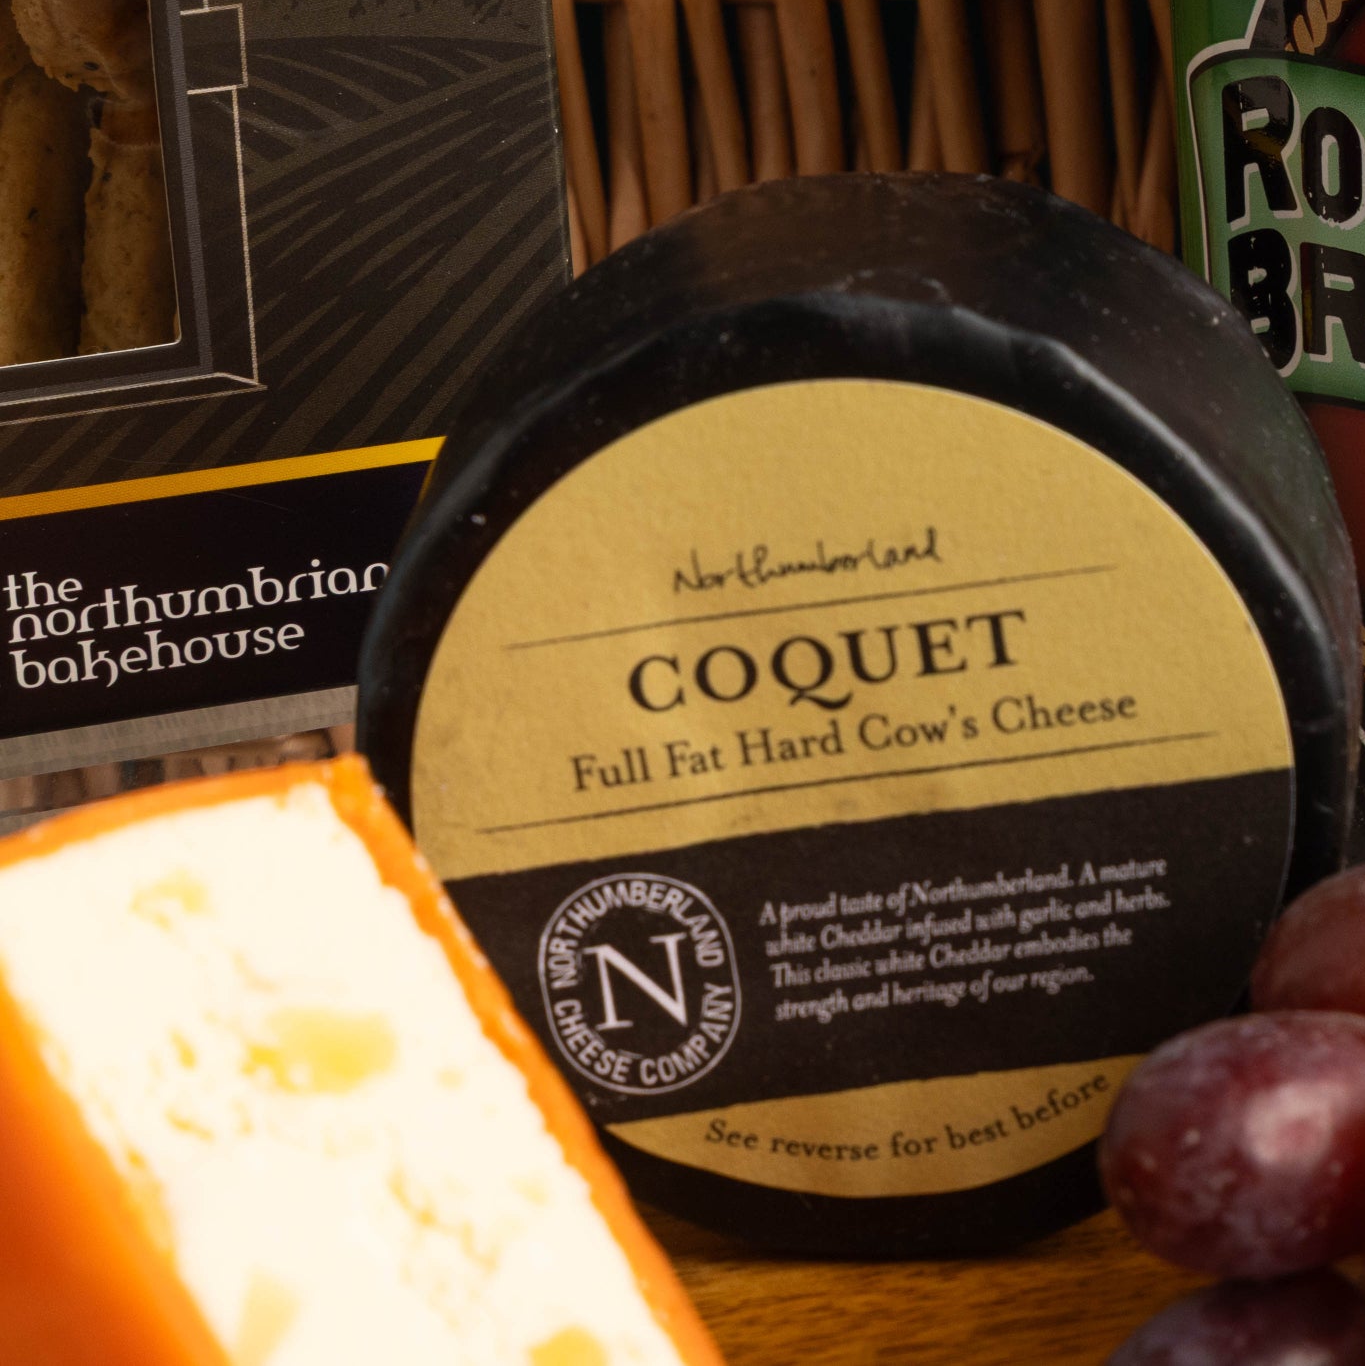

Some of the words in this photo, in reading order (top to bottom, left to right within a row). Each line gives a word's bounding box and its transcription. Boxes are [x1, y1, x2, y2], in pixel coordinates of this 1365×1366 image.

[3, 571, 83, 612] the
[8, 559, 390, 644] northumbrian
[9, 622, 305, 689] bakehouse
[627, 609, 1027, 713] COQUET
[569, 746, 653, 793] Full
[664, 739, 727, 779] Fat
[735, 718, 846, 768] Hard
[857, 703, 979, 751] Cow's
[991, 693, 1138, 735] Cheese
[548, 880, 725, 990] NORTHUMBERLAND
[758, 901, 777, 926] A
[779, 891, 837, 931] proud
[840, 892, 884, 916] taste
[886, 882, 909, 917] of
[909, 863, 1074, 907] Northumberland.
[1078, 861, 1097, 885] A
[1099, 859, 1167, 882] mature
[765, 930, 816, 957] white
[820, 918, 903, 951] Cheddar
[905, 908, 972, 947] infused
[975, 903, 1016, 930] with
[1018, 895, 1072, 934] garlic
[1074, 890, 1112, 919] and
[1115, 884, 1171, 912] herbs.
[582, 932, 688, 1031] N
[769, 961, 811, 987] This
[814, 957, 872, 983] classic
[875, 949, 926, 975] white
[929, 938, 1012, 969] Cheddar
[1014, 927, 1100, 959] embodies
[1103, 922, 1132, 947] the
[775, 988, 849, 1024] strength
[852, 982, 889, 1011] and
[893, 981, 967, 1008] heritage
[969, 969, 994, 1003] of
[993, 973, 1028, 993] our
[1030, 963, 1095, 995] region.
[554, 998, 633, 1083] CHEESE
[639, 982, 734, 1086] COMPANY
[704, 1117, 760, 1151] See
[769, 1136, 880, 1161] reverse
[890, 1130, 938, 1159] for
[944, 1119, 1006, 1151] best
[1010, 1072, 1112, 1131] before
